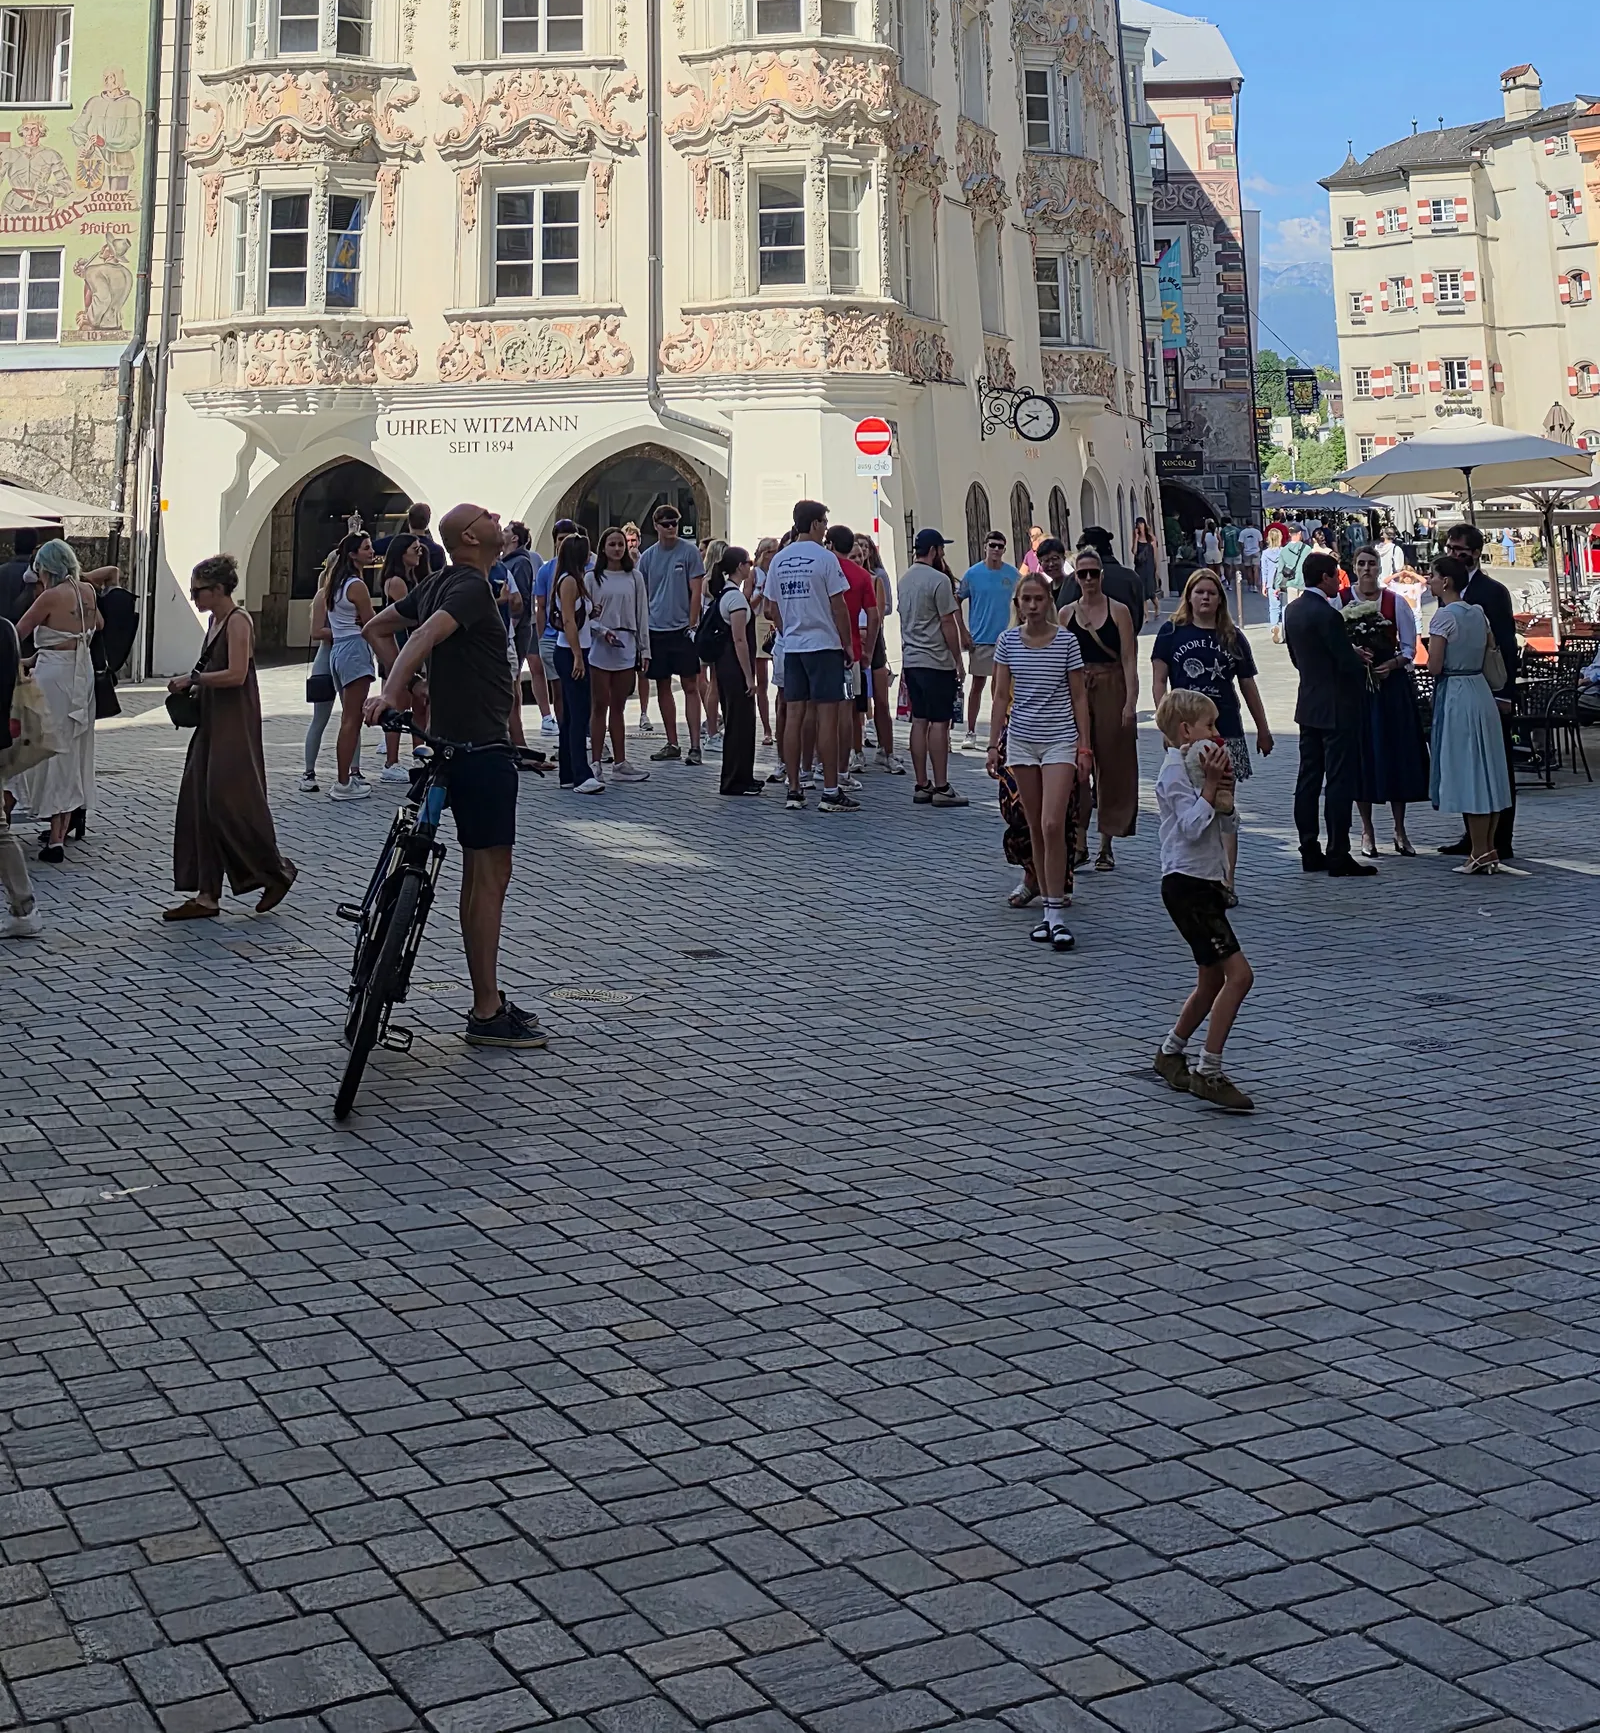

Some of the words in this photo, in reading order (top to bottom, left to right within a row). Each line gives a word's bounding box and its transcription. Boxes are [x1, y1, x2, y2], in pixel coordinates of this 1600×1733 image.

[386, 418, 457, 436] UHREN
[463, 415, 579, 434] WITZMANN
[449, 441, 480, 453] SEIT
[486, 440, 514, 453] 1894
[1162, 459, 1197, 468] XOCOLAT
